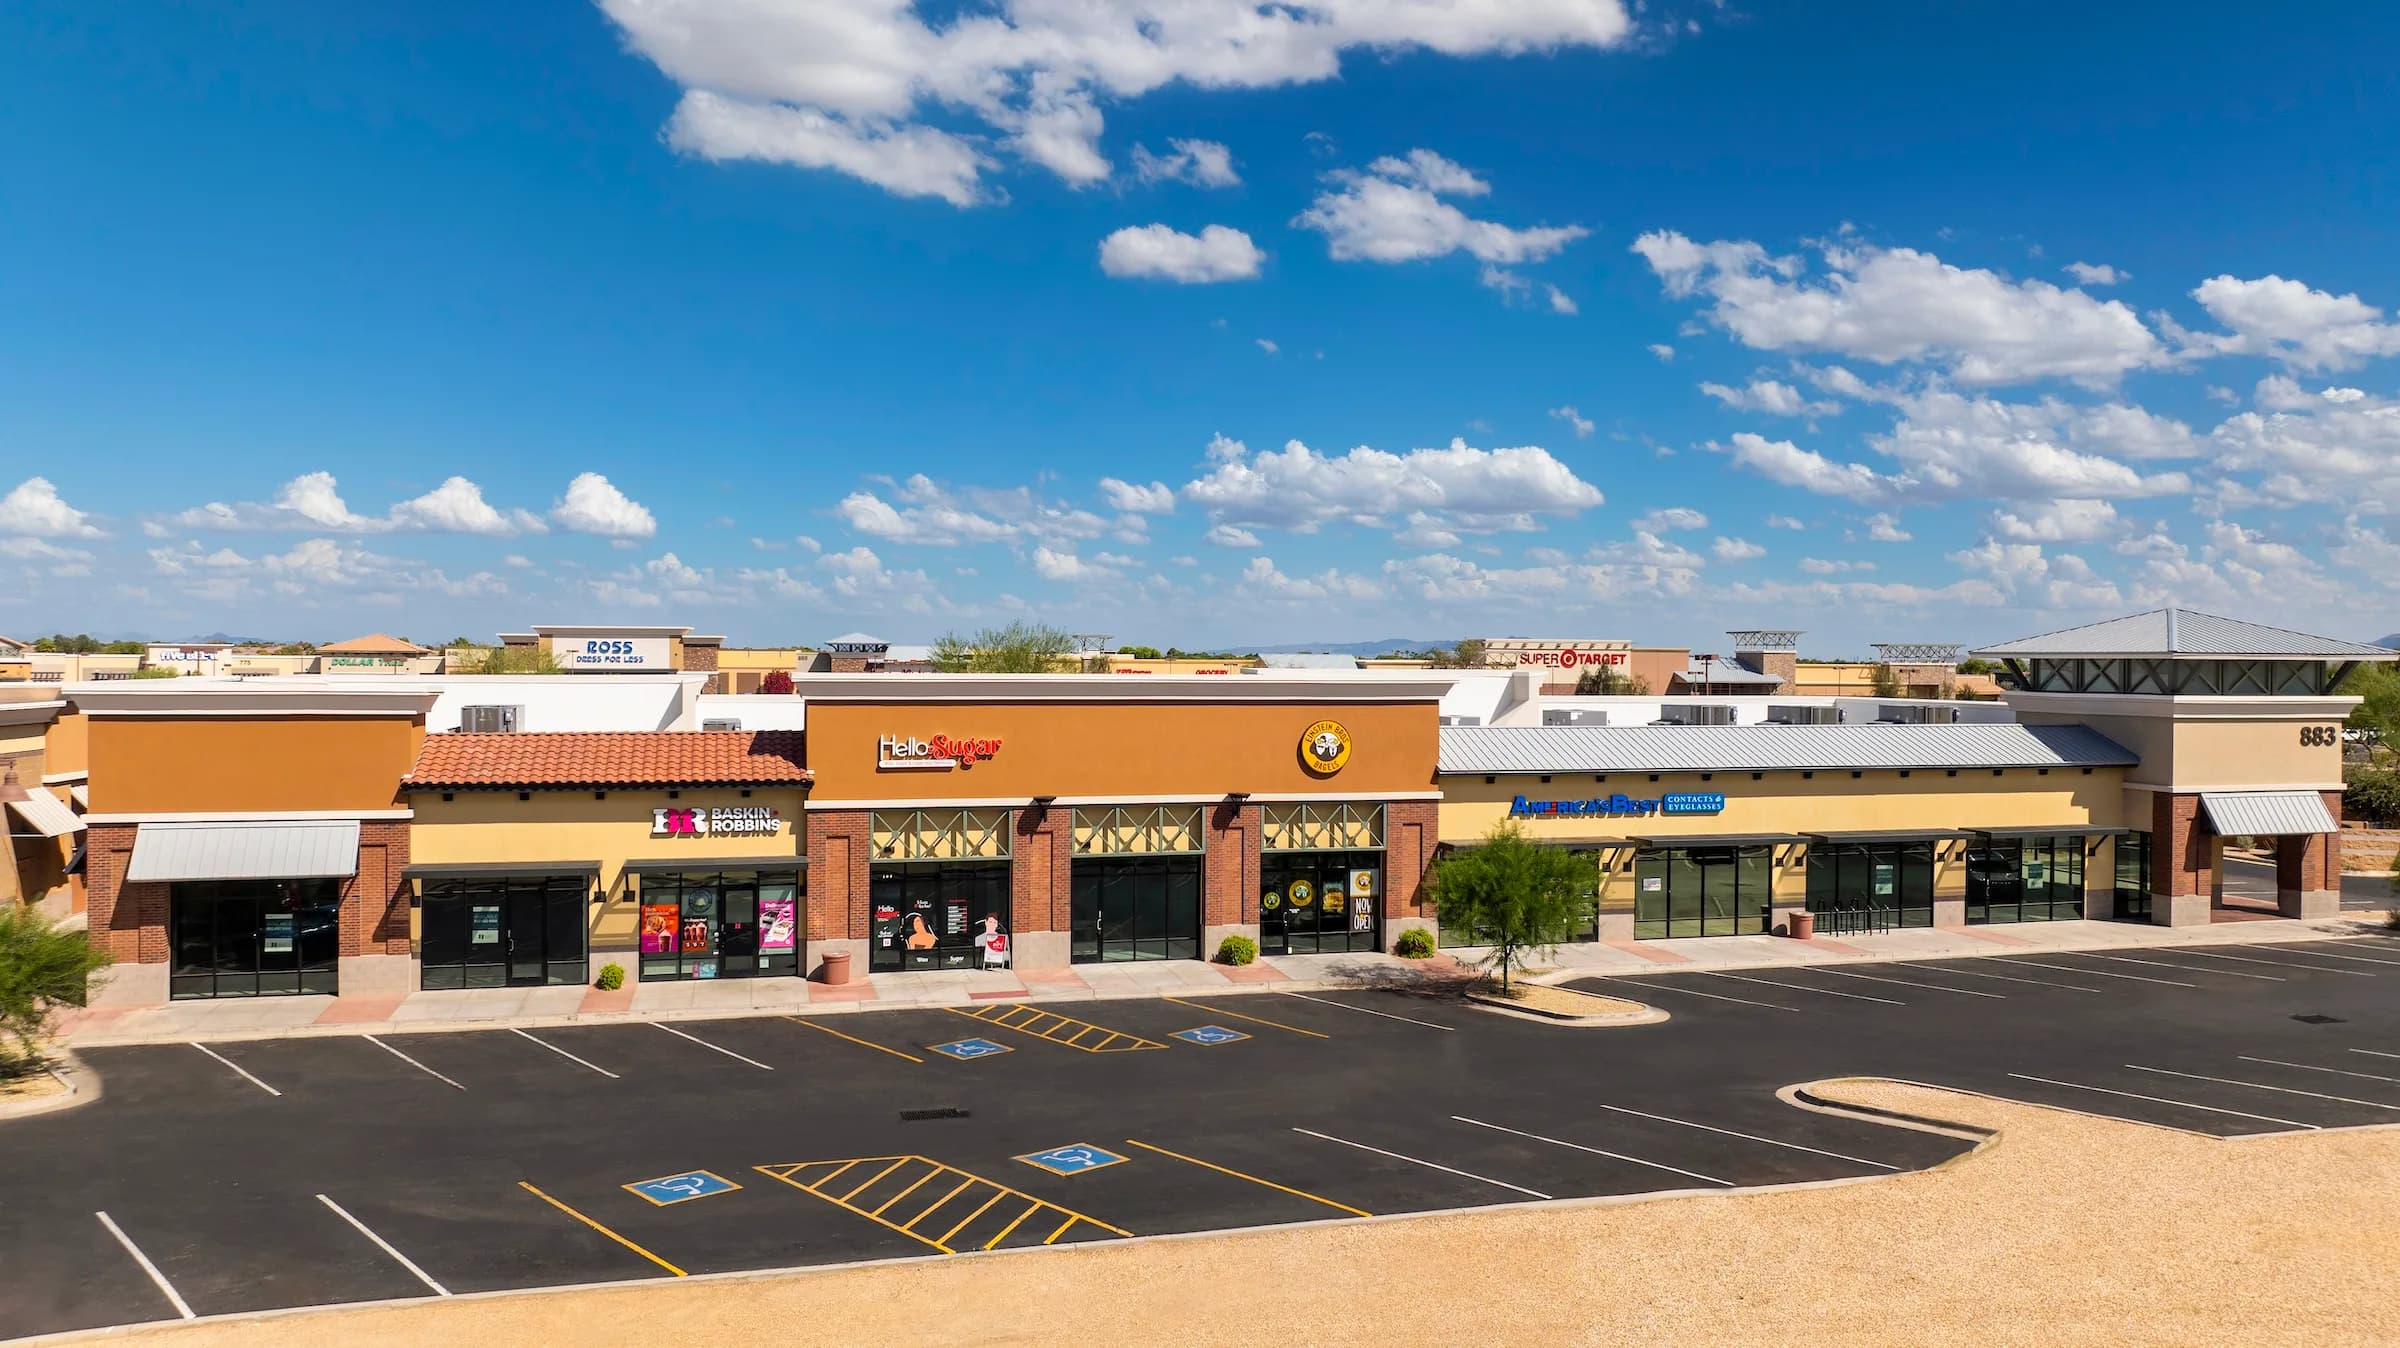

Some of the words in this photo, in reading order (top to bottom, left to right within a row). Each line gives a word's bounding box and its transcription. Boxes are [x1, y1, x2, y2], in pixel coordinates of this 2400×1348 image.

[587, 641, 633, 654] ROSS
[331, 656, 374, 666] DOLLAR
[1520, 653, 1559, 665] SUPER
[1577, 653, 1627, 665] TARGET
[1305, 722, 1333, 743] EINSTEIN
[1335, 725, 1350, 744] BROS
[2300, 726, 2336, 747] 883
[880, 734, 929, 760] Hello
[929, 733, 1003, 765] Sugar
[1313, 760, 1340, 771] BAGELS
[711, 807, 771, 820] BASKIN
[1668, 803, 1721, 811] EYEGLASSES
[711, 819, 781, 832] ROBBINS
[1355, 898, 1373, 914] NOW
[1354, 914, 1375, 930] OPEN
